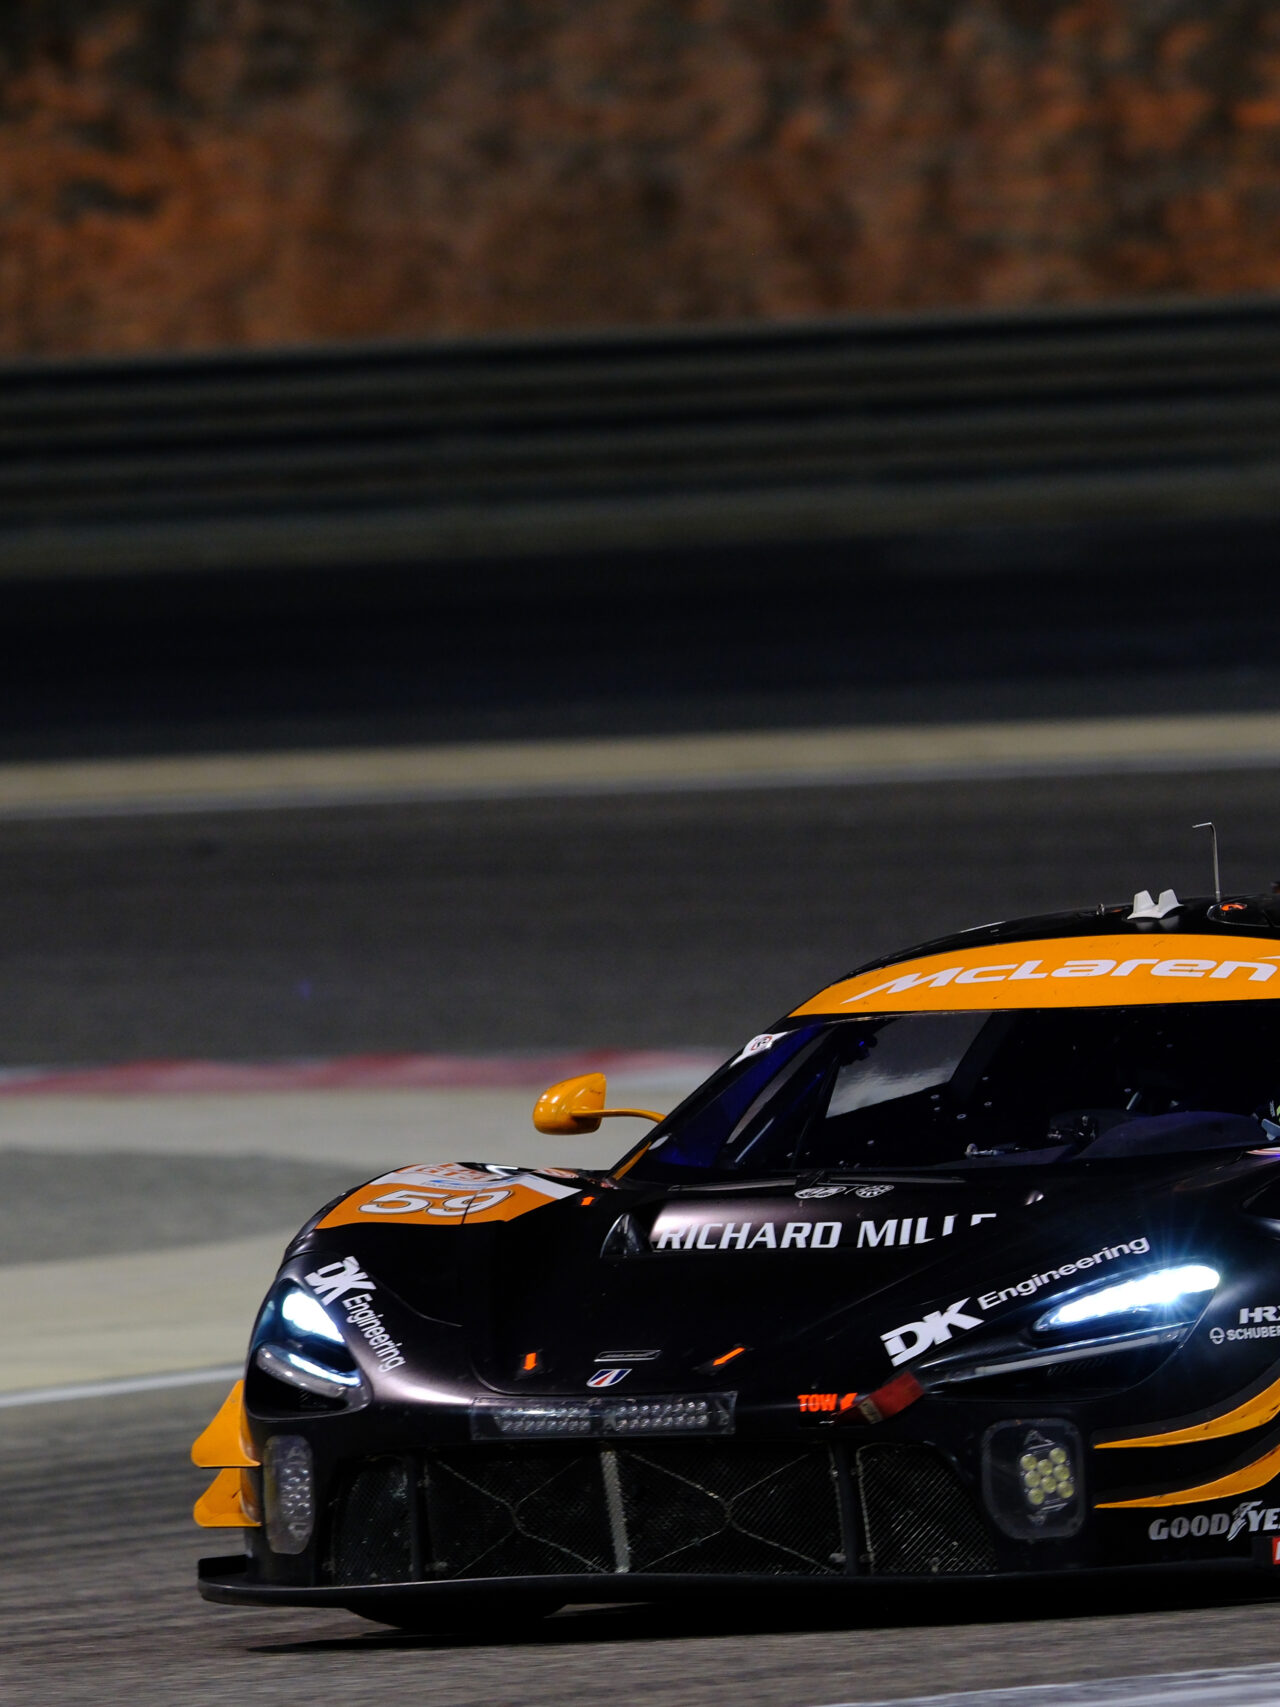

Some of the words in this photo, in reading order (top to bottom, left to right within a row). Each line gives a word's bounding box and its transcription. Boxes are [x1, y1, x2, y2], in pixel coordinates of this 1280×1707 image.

[358, 1189, 515, 1217] 59
[656, 1222, 842, 1250] RICHARD
[304, 1255, 377, 1306] DK
[880, 1297, 985, 1367] DK
[977, 1237, 1151, 1311] Engineering
[342, 1293, 406, 1373] Engineering
[798, 1394, 838, 1412] TOW
